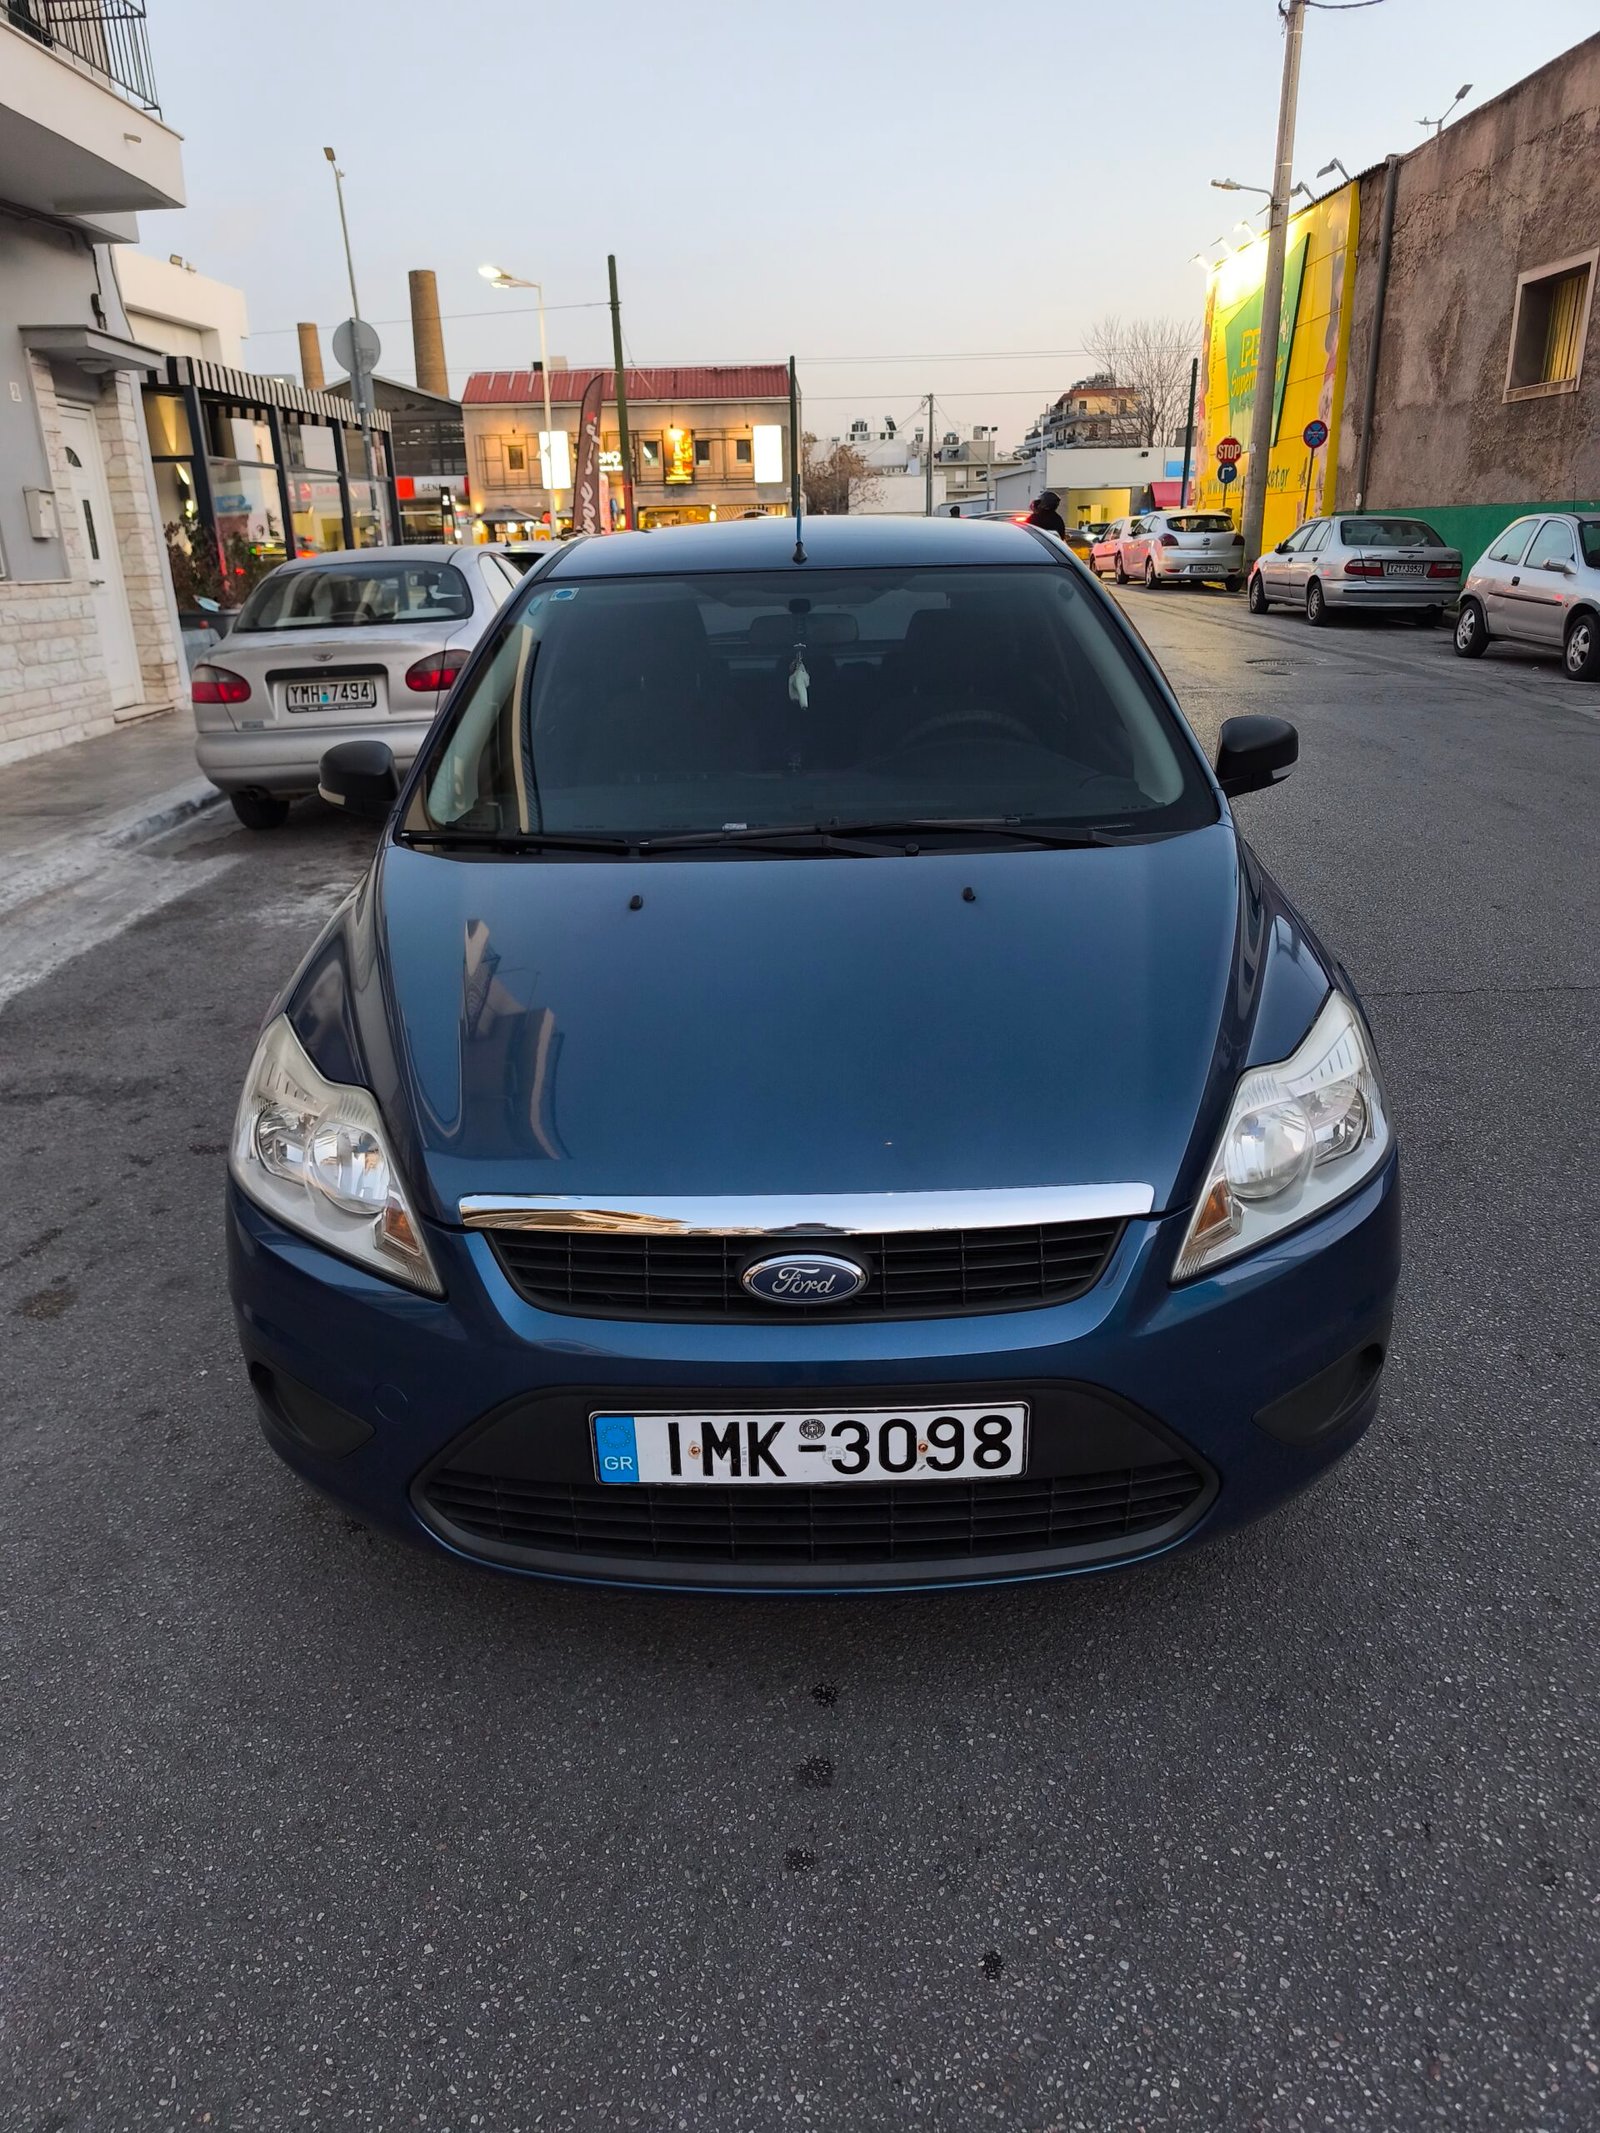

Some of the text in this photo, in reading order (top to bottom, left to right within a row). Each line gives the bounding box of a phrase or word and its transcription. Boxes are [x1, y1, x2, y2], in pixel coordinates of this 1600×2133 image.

[1241, 327, 1262, 368] PE
[1217, 444, 1240, 459] STOP
[772, 1267, 836, 1294] Ford
[604, 1456, 634, 1471] GR
